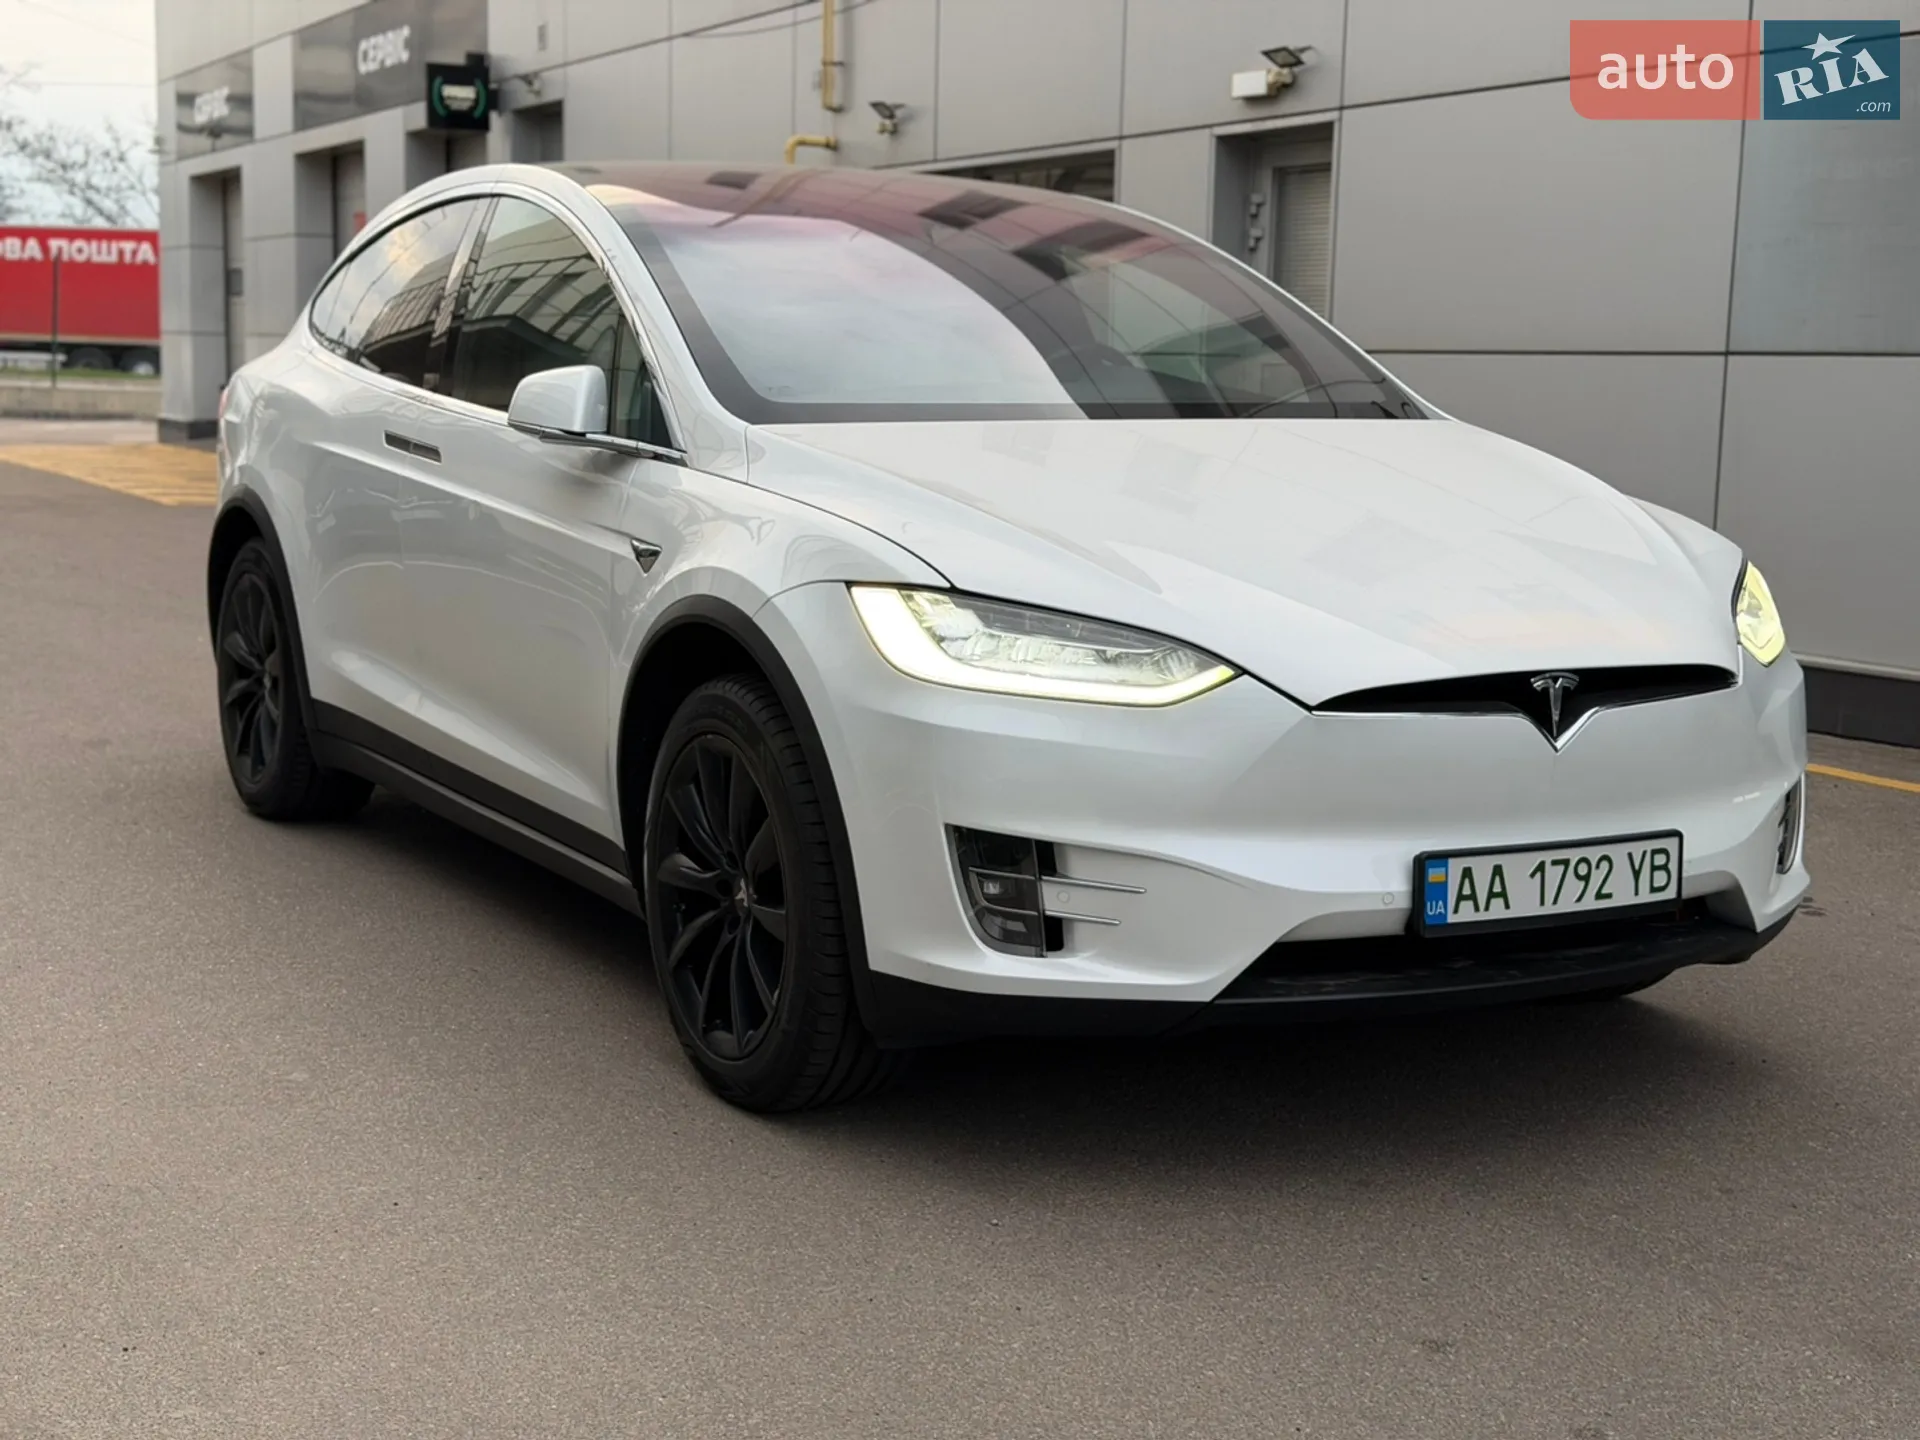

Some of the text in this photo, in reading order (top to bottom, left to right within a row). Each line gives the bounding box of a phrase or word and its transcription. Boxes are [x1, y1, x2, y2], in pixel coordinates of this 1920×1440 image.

[0, 236, 157, 265] ВА ПОШТА
[1453, 847, 1672, 915] AA 1792 YB
[1426, 901, 1446, 916] UA
